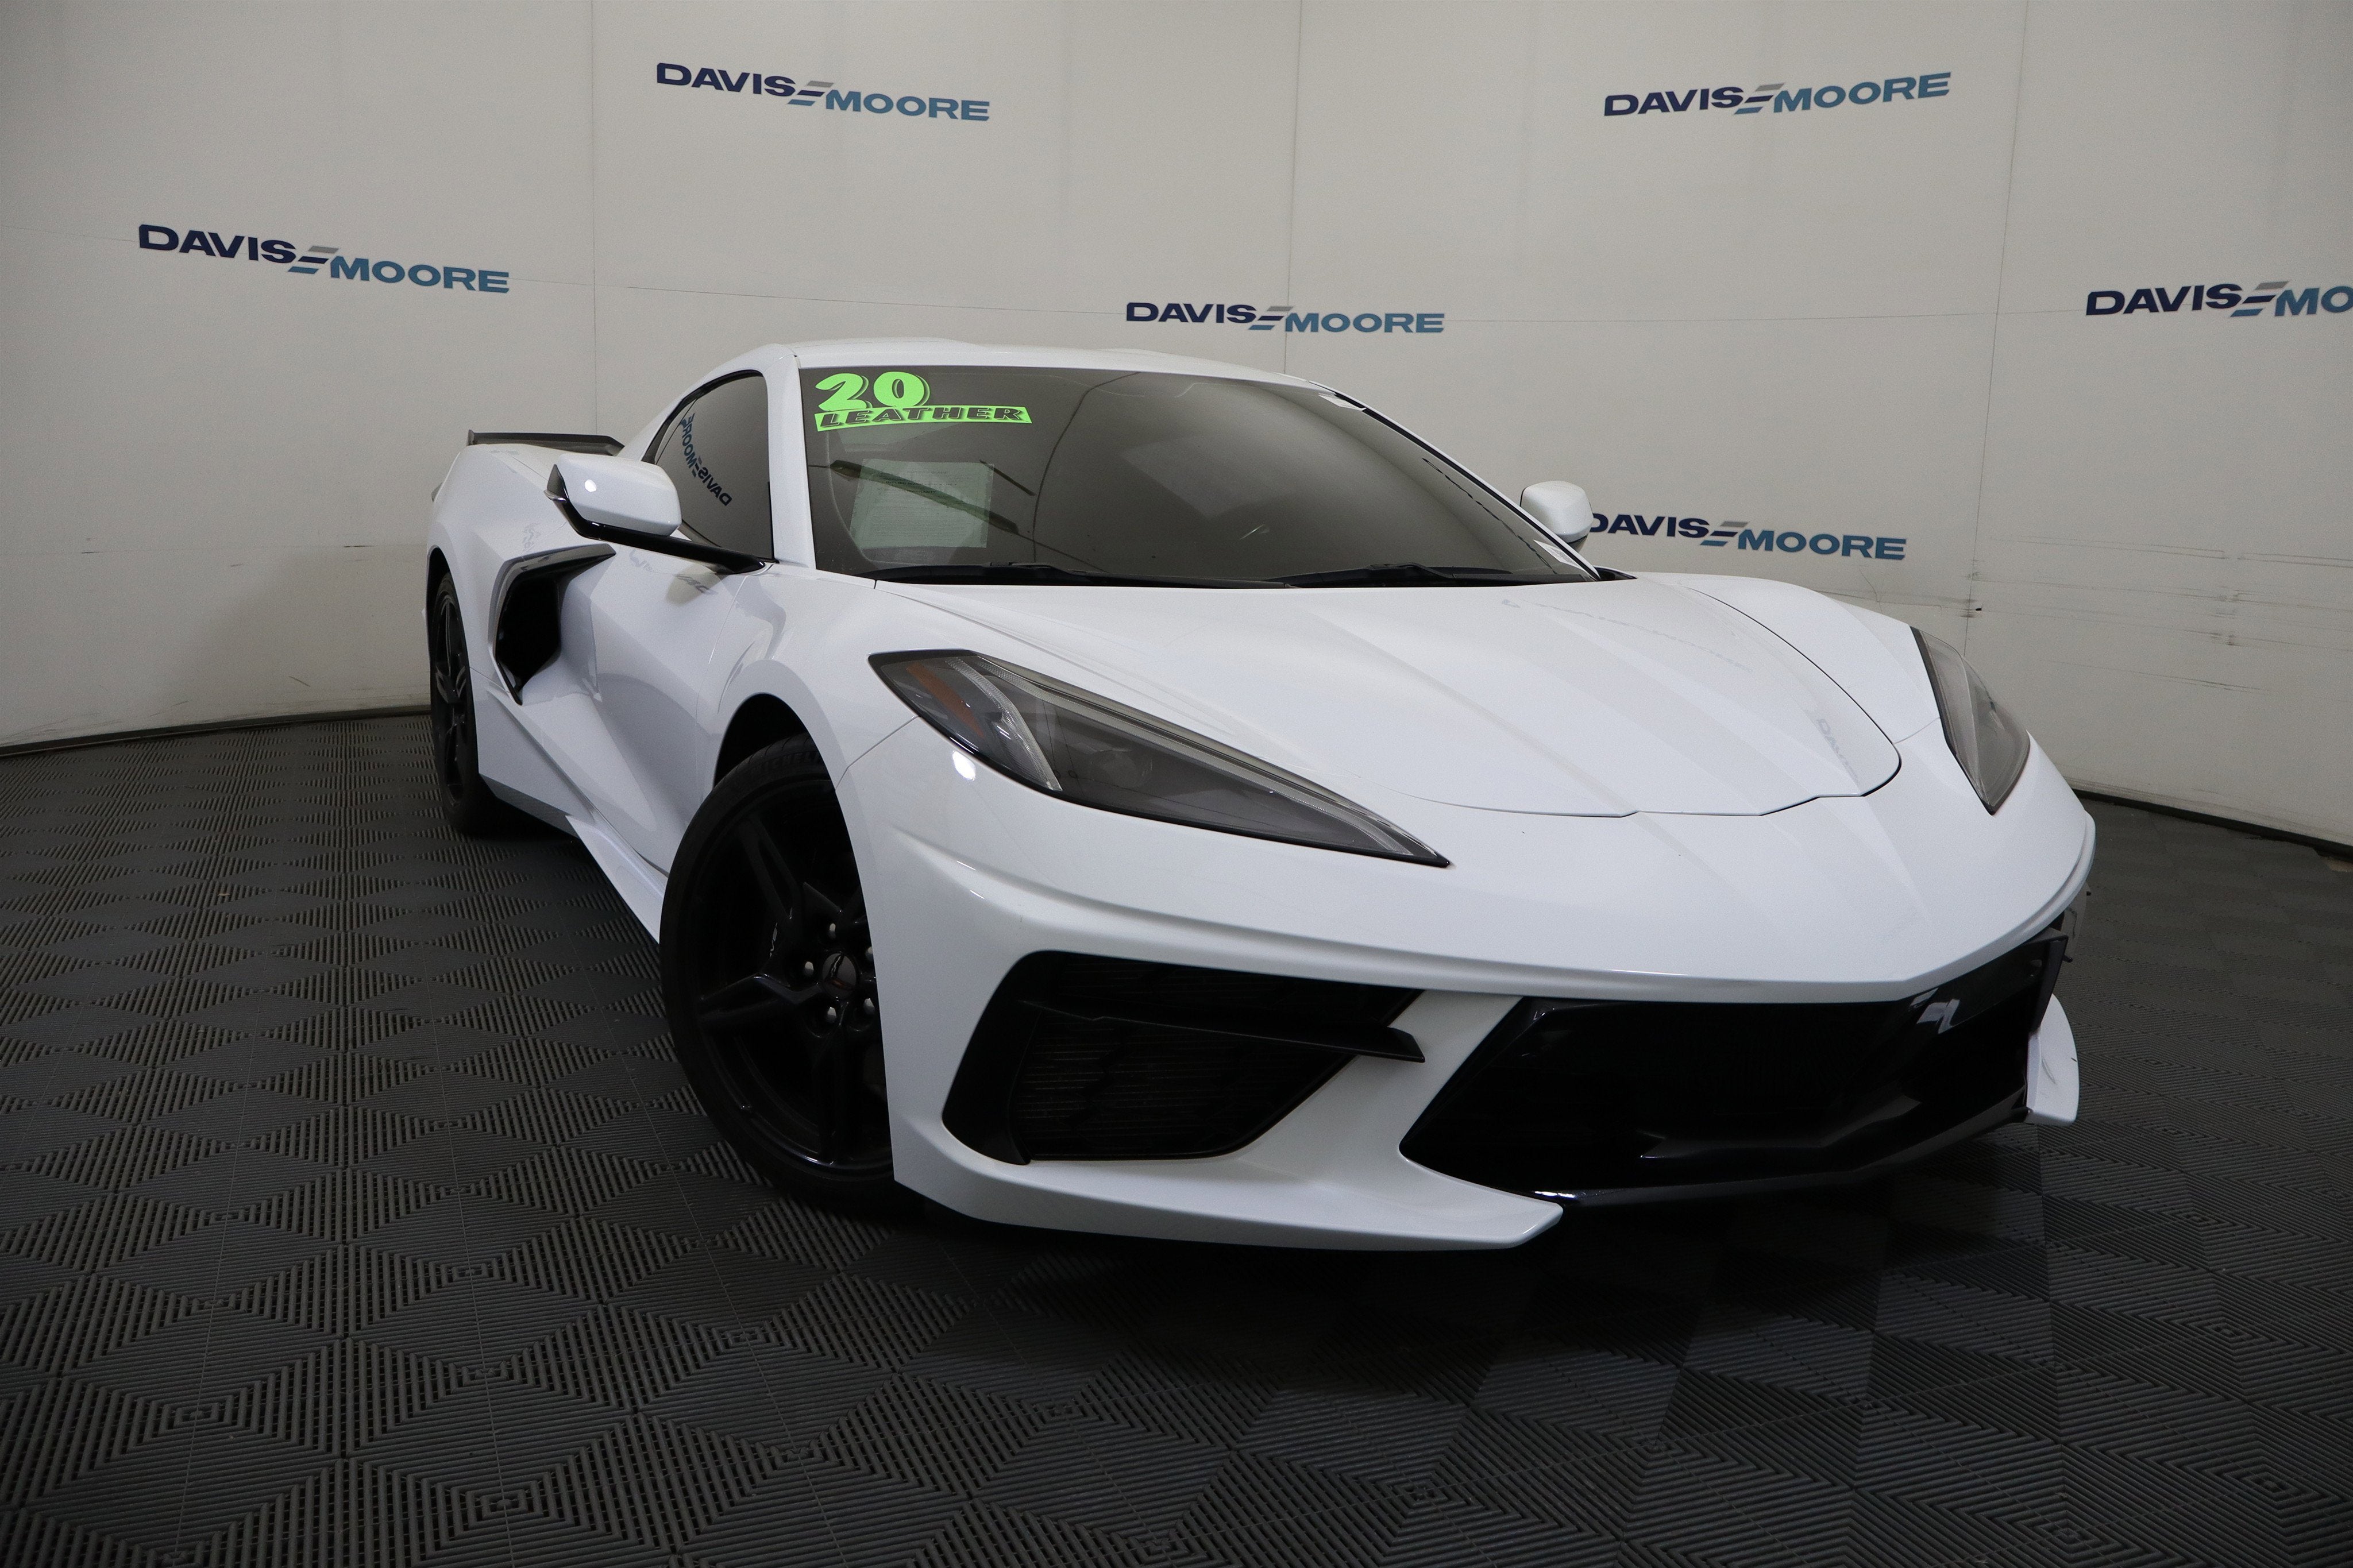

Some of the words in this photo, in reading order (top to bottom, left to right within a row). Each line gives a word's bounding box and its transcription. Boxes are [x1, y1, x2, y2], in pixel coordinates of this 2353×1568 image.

[657, 63, 796, 97] DAVIS
[826, 89, 990, 122] MOORE
[1604, 86, 1743, 116] DAVIS
[1773, 72, 1951, 114] MOORE
[138, 224, 296, 264] DAVIS
[330, 255, 510, 294] MOORE
[1126, 302, 1256, 324] DAVIS
[1284, 312, 1445, 333] MOORE
[2086, 283, 2243, 316] DAVIS
[815, 371, 930, 411] 20
[820, 407, 1023, 428] LEATHER
[1738, 528, 1907, 561] MOORE
